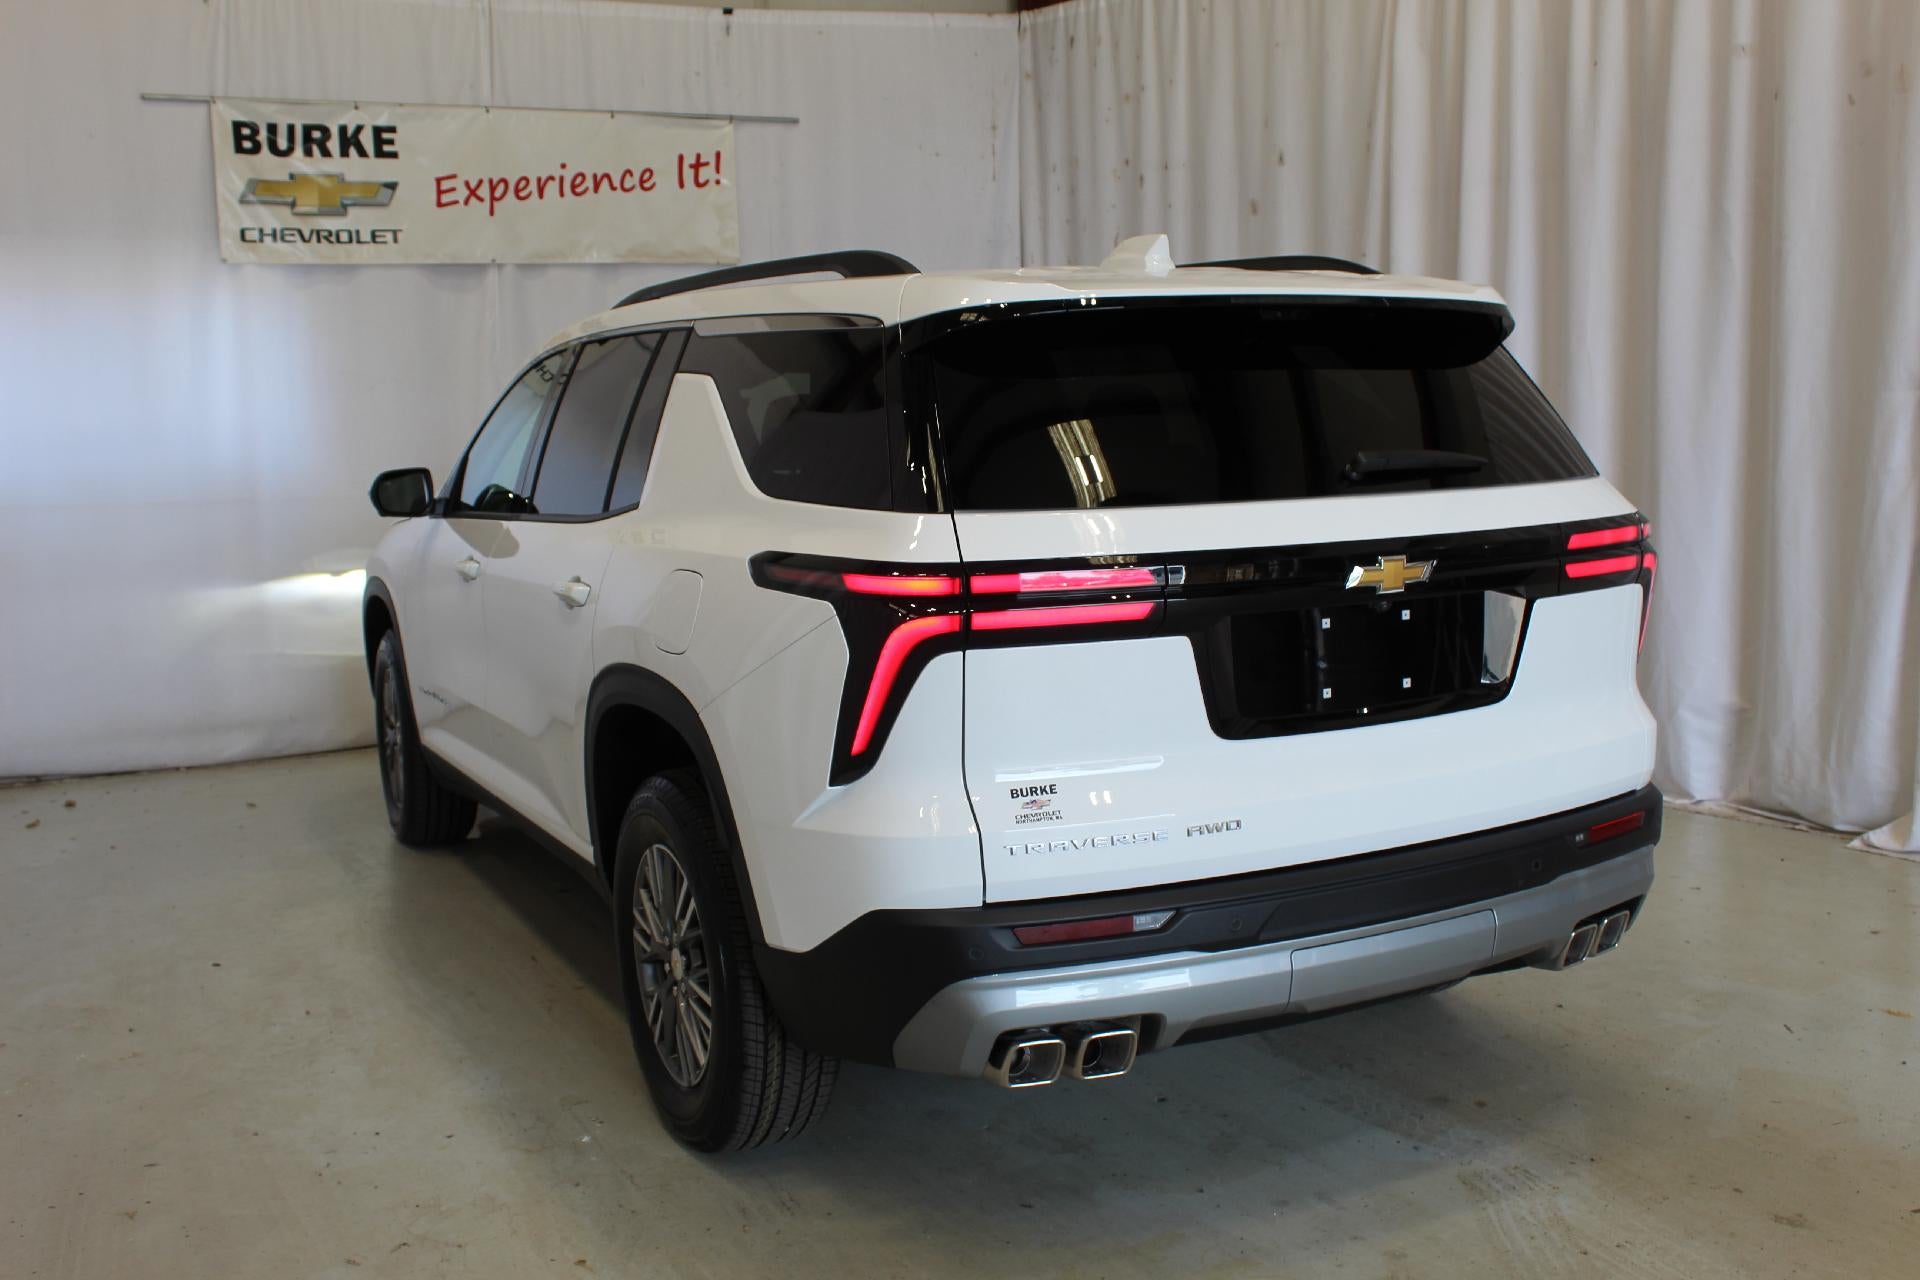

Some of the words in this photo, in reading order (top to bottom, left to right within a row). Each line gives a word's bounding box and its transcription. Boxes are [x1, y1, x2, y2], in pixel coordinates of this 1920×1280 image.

[231, 119, 399, 160] BURKE
[434, 162, 657, 217] Experience
[676, 150, 722, 190] It!
[239, 226, 403, 245] CHEVROLET
[1010, 784, 1058, 799] BURKE
[1015, 810, 1062, 820] CHEVROLET
[1003, 829, 1169, 857] TRAVERSE
[1186, 819, 1242, 838] AWD
